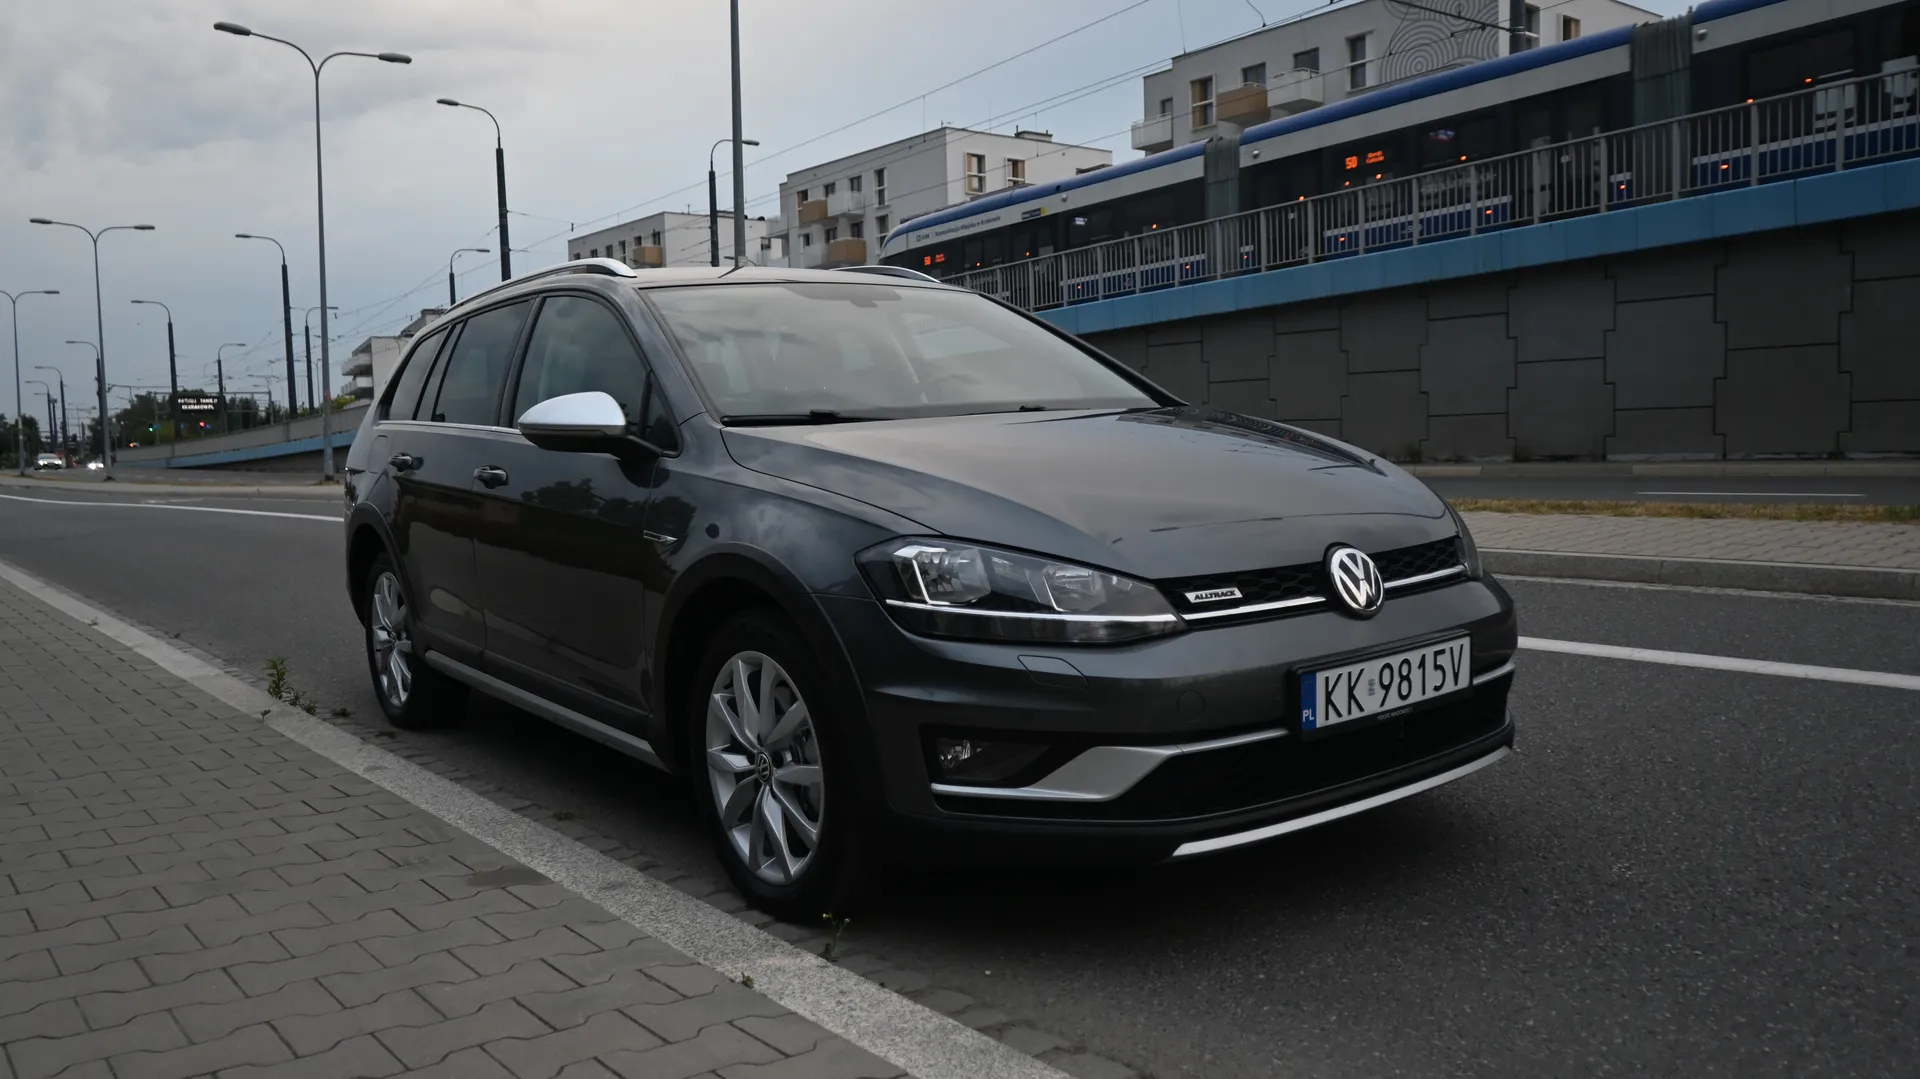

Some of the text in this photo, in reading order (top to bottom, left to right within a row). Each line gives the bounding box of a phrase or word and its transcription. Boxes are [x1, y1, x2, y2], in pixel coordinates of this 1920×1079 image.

[1194, 589, 1237, 601] ALLTRACK
[1324, 643, 1464, 721] KK 9815V
[1302, 708, 1315, 722] PL
